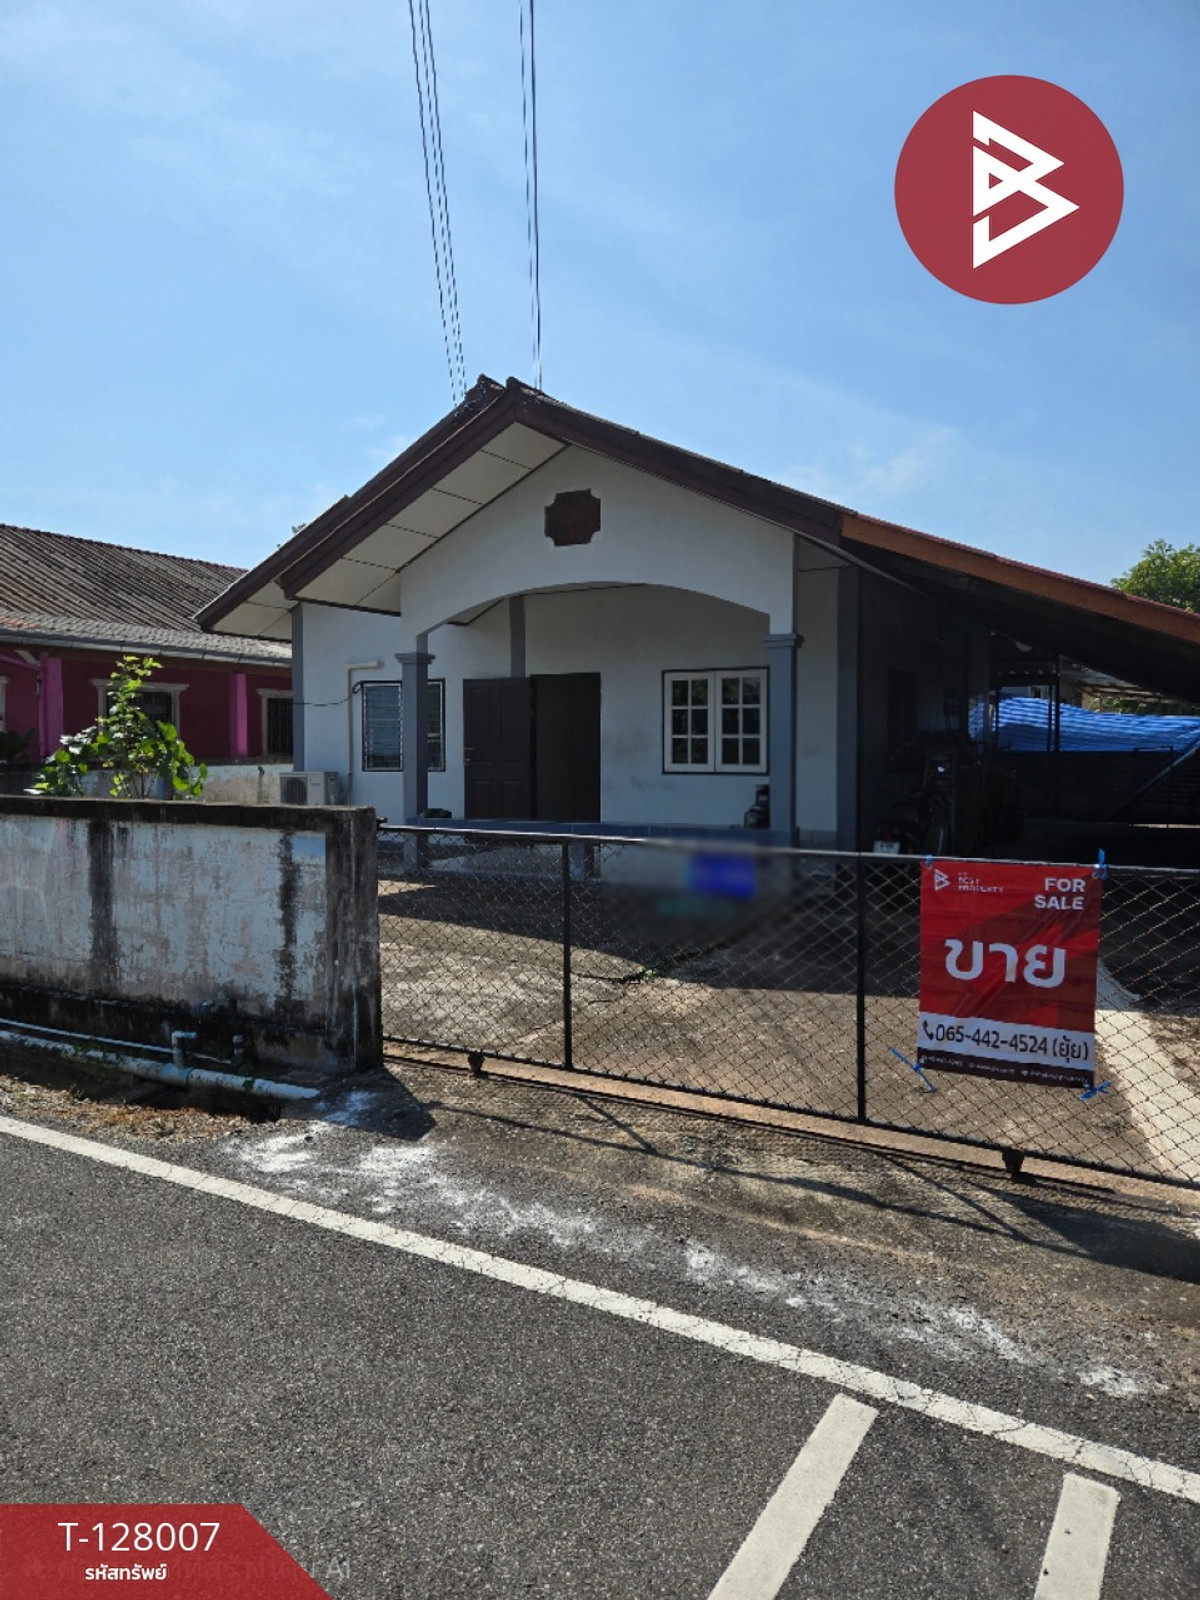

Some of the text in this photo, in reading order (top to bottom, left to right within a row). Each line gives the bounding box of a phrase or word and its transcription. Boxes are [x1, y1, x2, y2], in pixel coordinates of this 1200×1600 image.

[1044, 877, 1086, 893] FOR
[1034, 895, 1085, 910] SALE
[944, 939, 1067, 989] ขาย
[935, 1024, 1048, 1054] 065-442-4524
